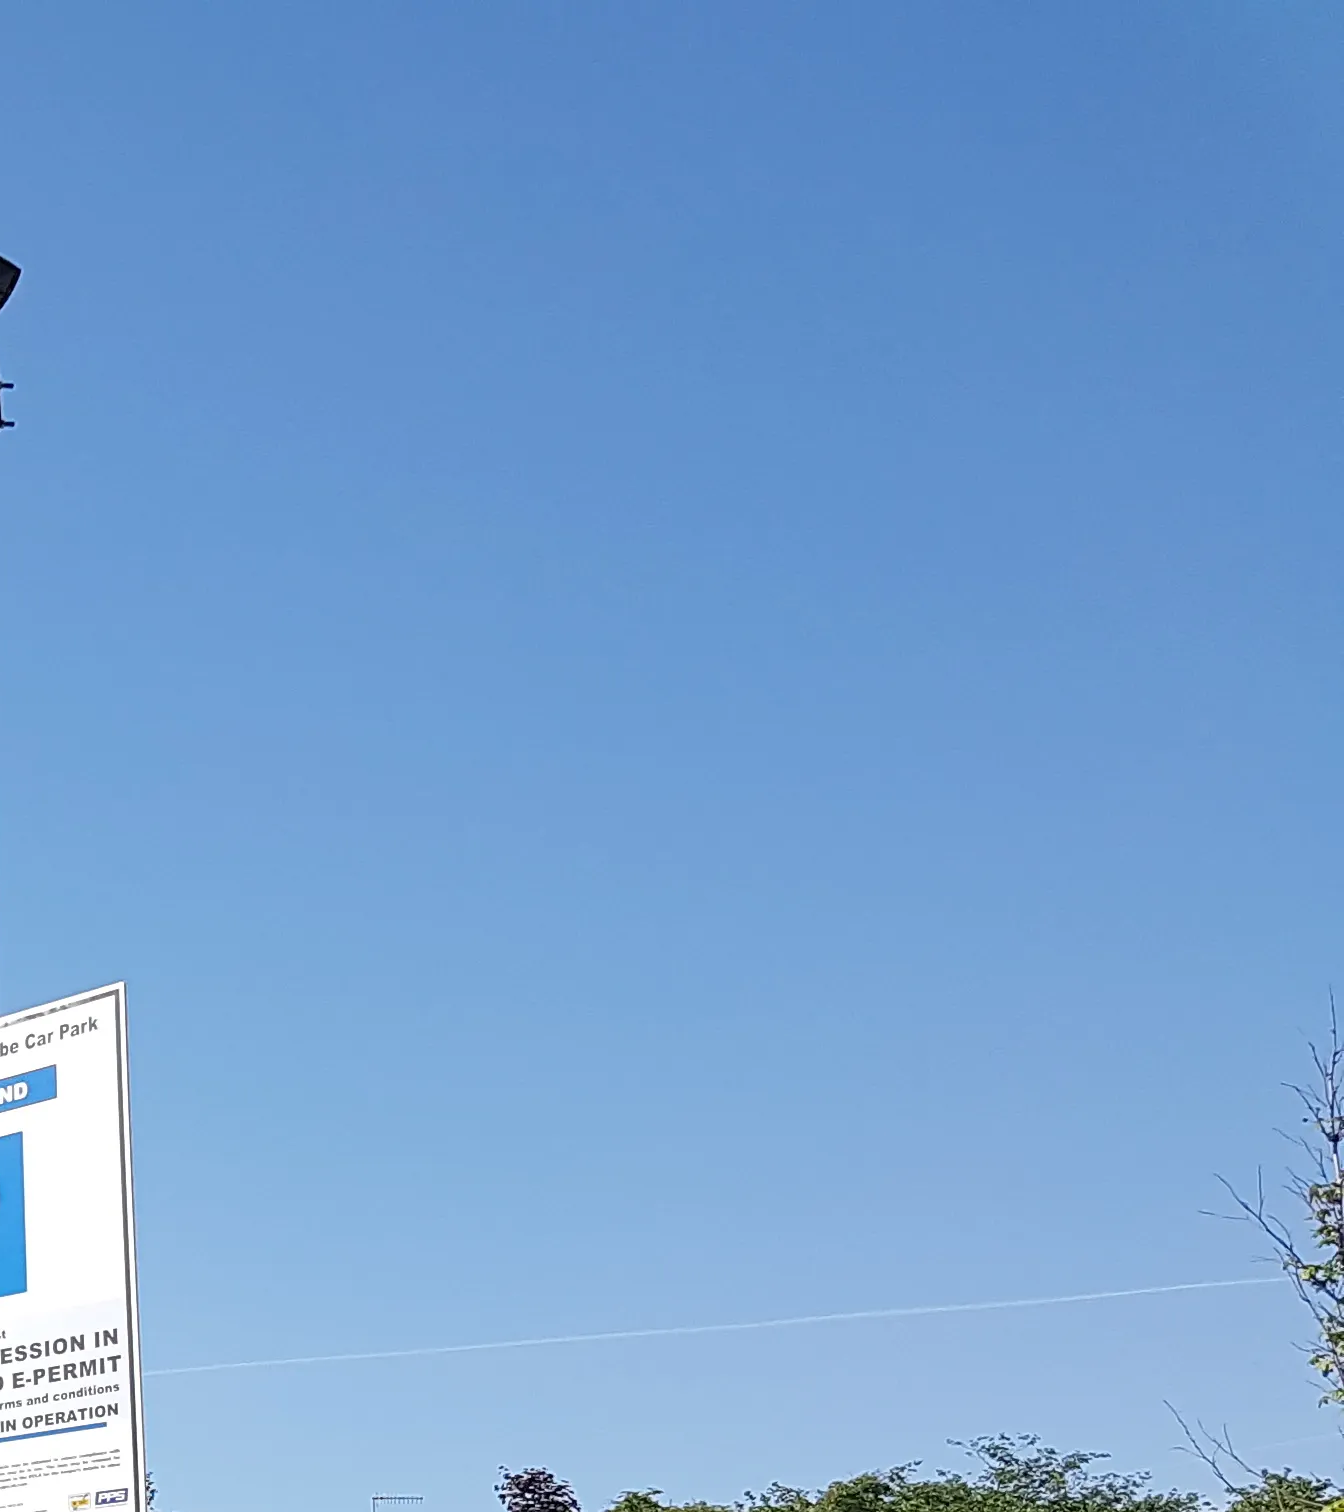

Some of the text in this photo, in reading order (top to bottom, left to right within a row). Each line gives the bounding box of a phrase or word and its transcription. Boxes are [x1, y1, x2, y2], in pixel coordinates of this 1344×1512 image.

[25, 1029, 54, 1051] Car
[59, 1016, 99, 1041] Park
[95, 1328, 119, 1348] IN
[12, 1354, 122, 1389] E-PERMIT
[26, 1392, 49, 1406] and
[53, 1383, 120, 1401] conditions
[0, 1418, 17, 1433] IN
[22, 1402, 119, 1429] OPERATION
[98, 1490, 126, 1504] PPS
